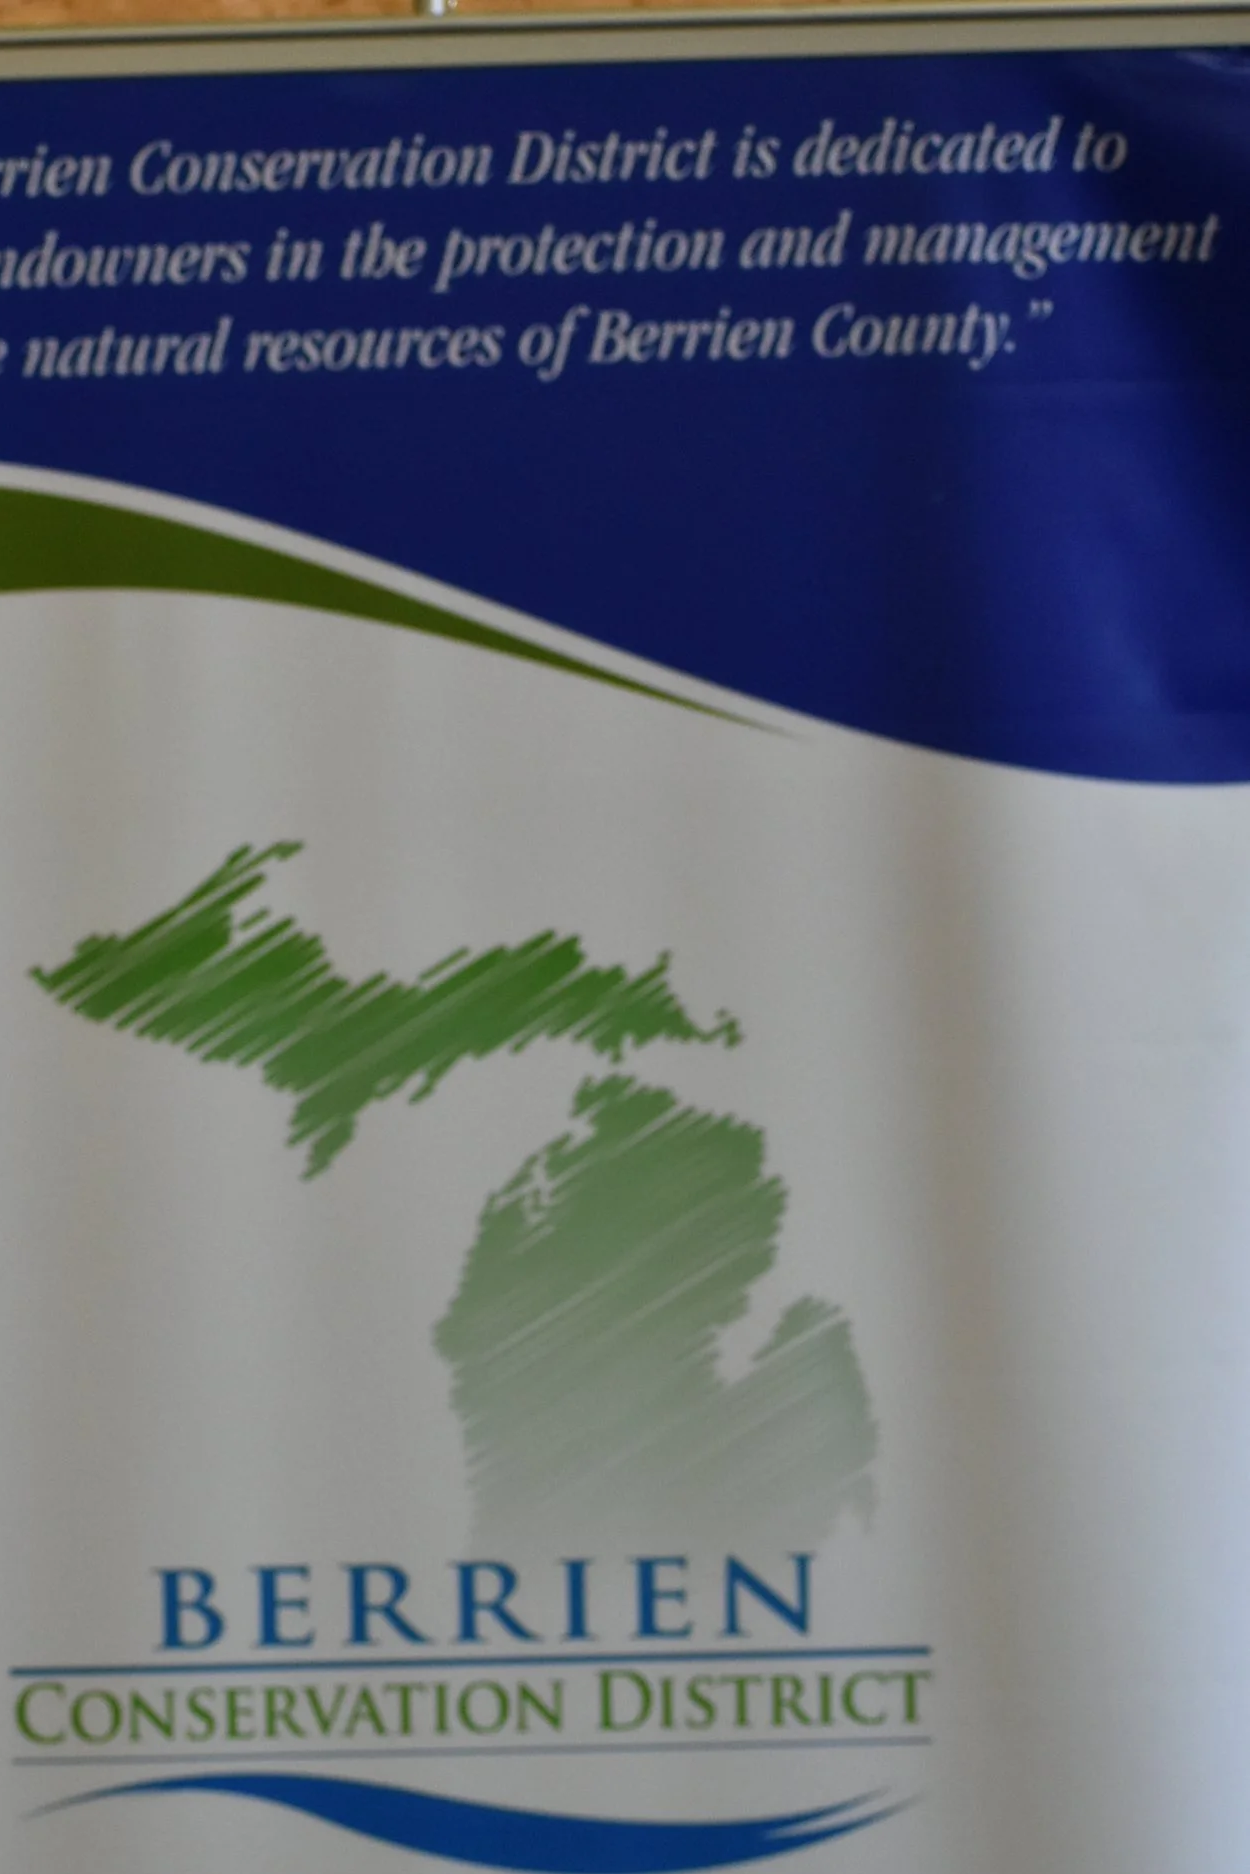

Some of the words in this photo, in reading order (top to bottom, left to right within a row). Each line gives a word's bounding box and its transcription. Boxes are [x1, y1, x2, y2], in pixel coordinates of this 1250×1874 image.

[129, 134, 492, 194] Conservation
[510, 127, 716, 184] District
[732, 126, 778, 180] is
[793, 115, 1065, 177] dedicated
[1073, 121, 1129, 173] to
[265, 227, 321, 282] in
[339, 222, 426, 280] the
[434, 218, 724, 292] protection
[739, 209, 853, 268] and
[864, 212, 1222, 280] management
[23, 316, 232, 379] natural
[244, 323, 503, 373] resources
[518, 306, 588, 382] of
[588, 307, 795, 365] Berrien
[156, 1551, 817, 1651] BERRIEN
[15, 1677, 565, 1745] CONSERVATION
[597, 1668, 934, 1734] DISTRICT
